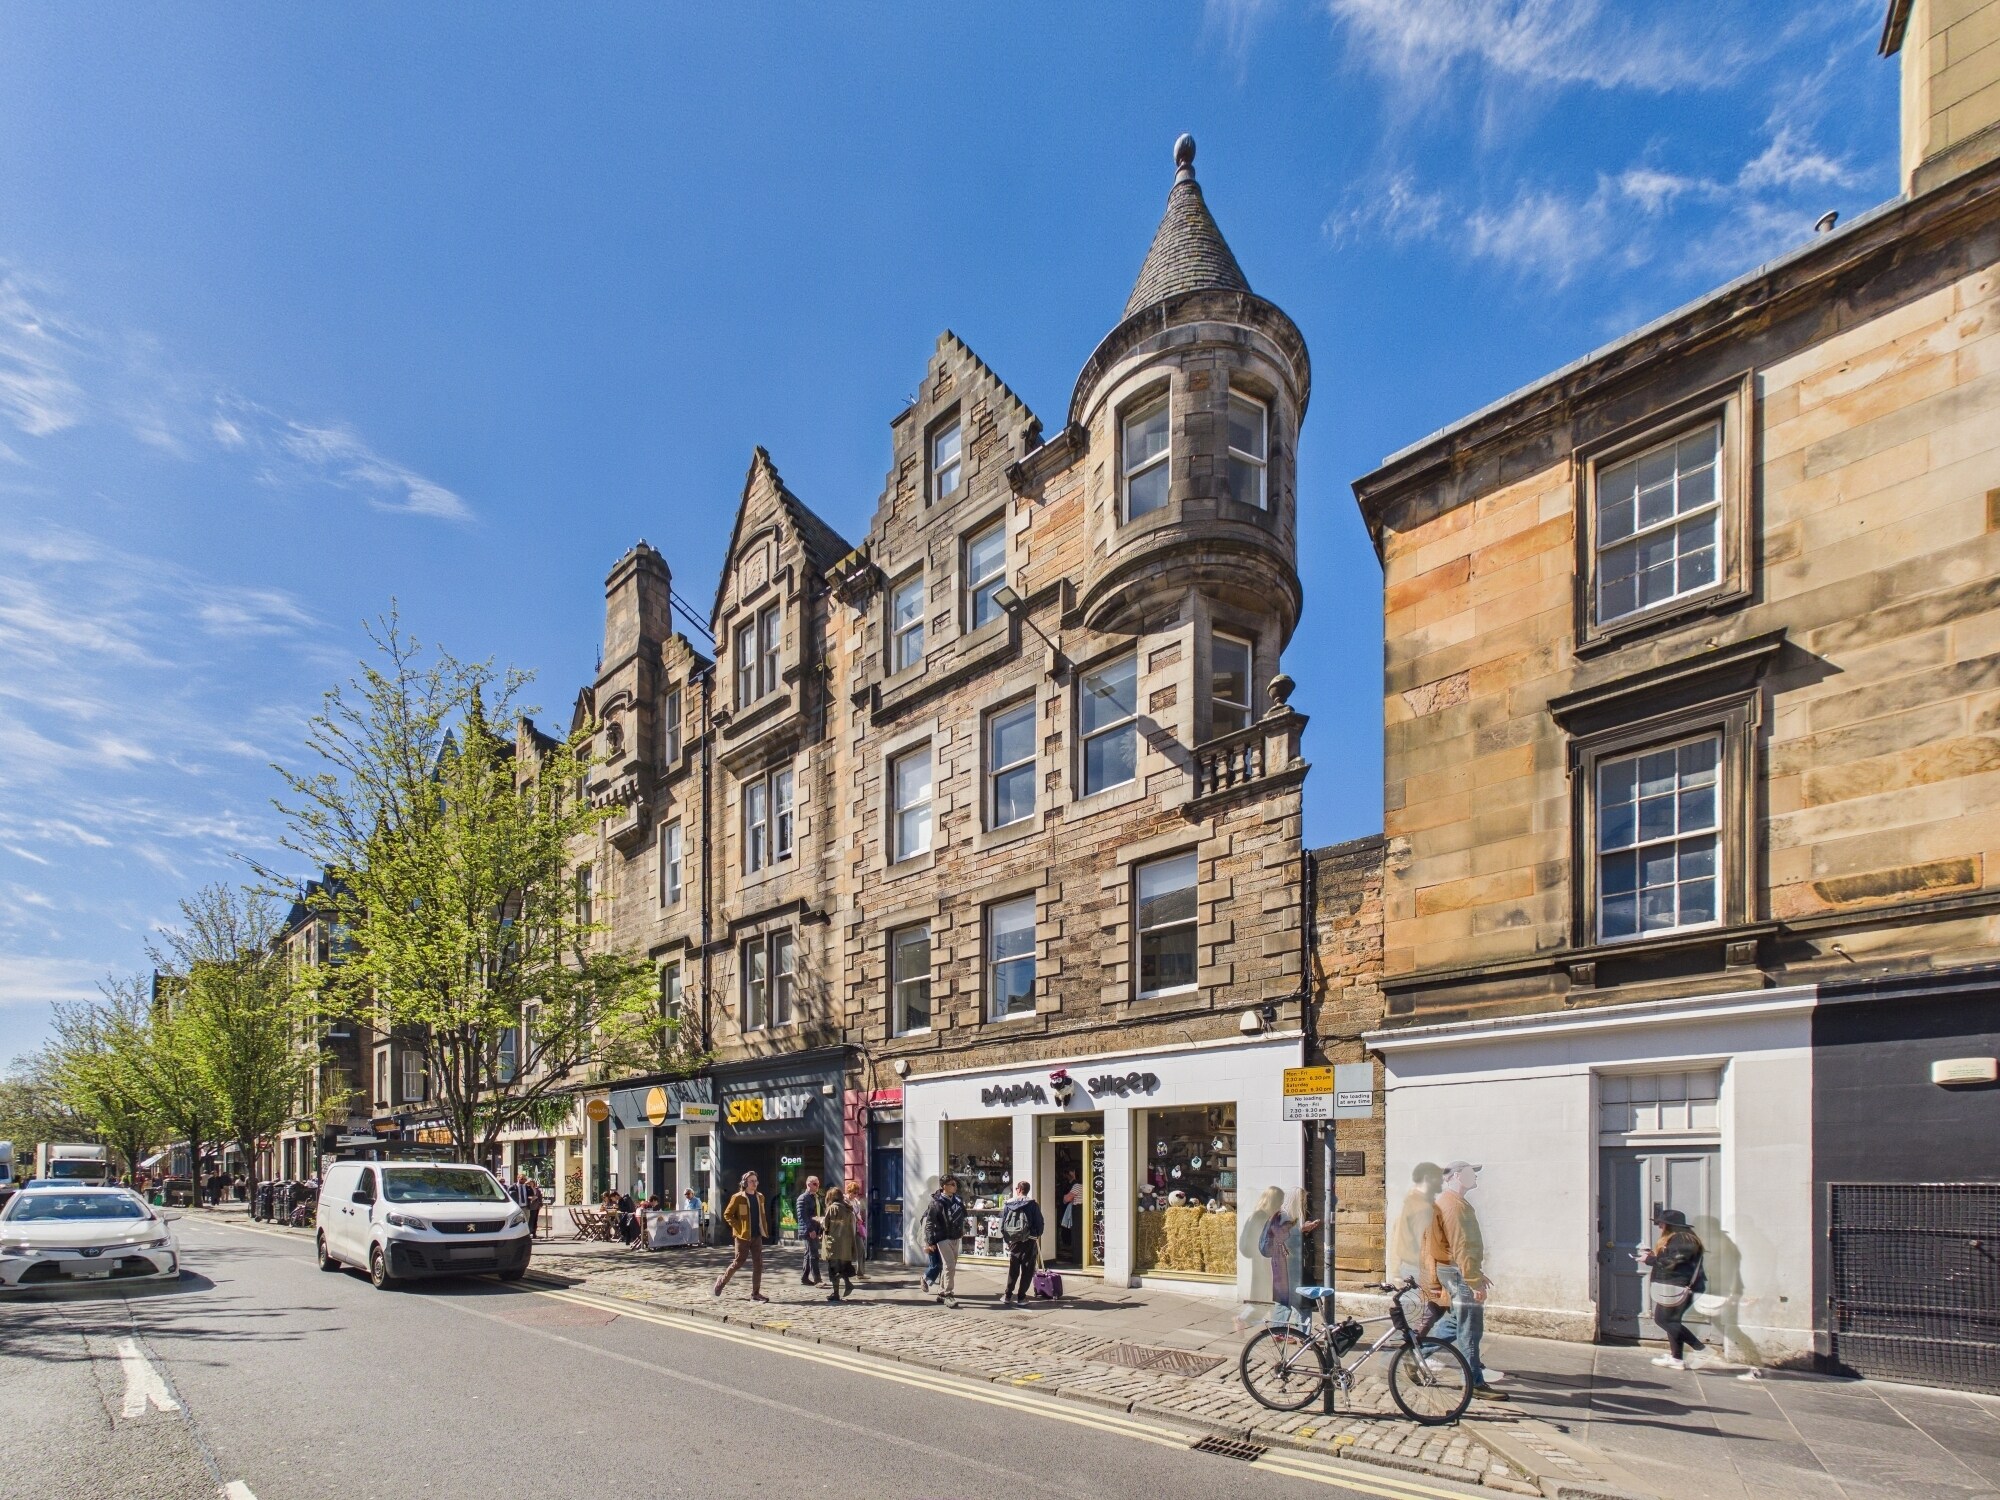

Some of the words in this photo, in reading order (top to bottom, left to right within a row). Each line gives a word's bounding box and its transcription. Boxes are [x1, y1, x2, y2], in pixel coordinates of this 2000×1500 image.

[685, 1107, 718, 1116] SUBWAY
[727, 1091, 815, 1125] SUBWAY
[781, 1156, 802, 1165] Open
